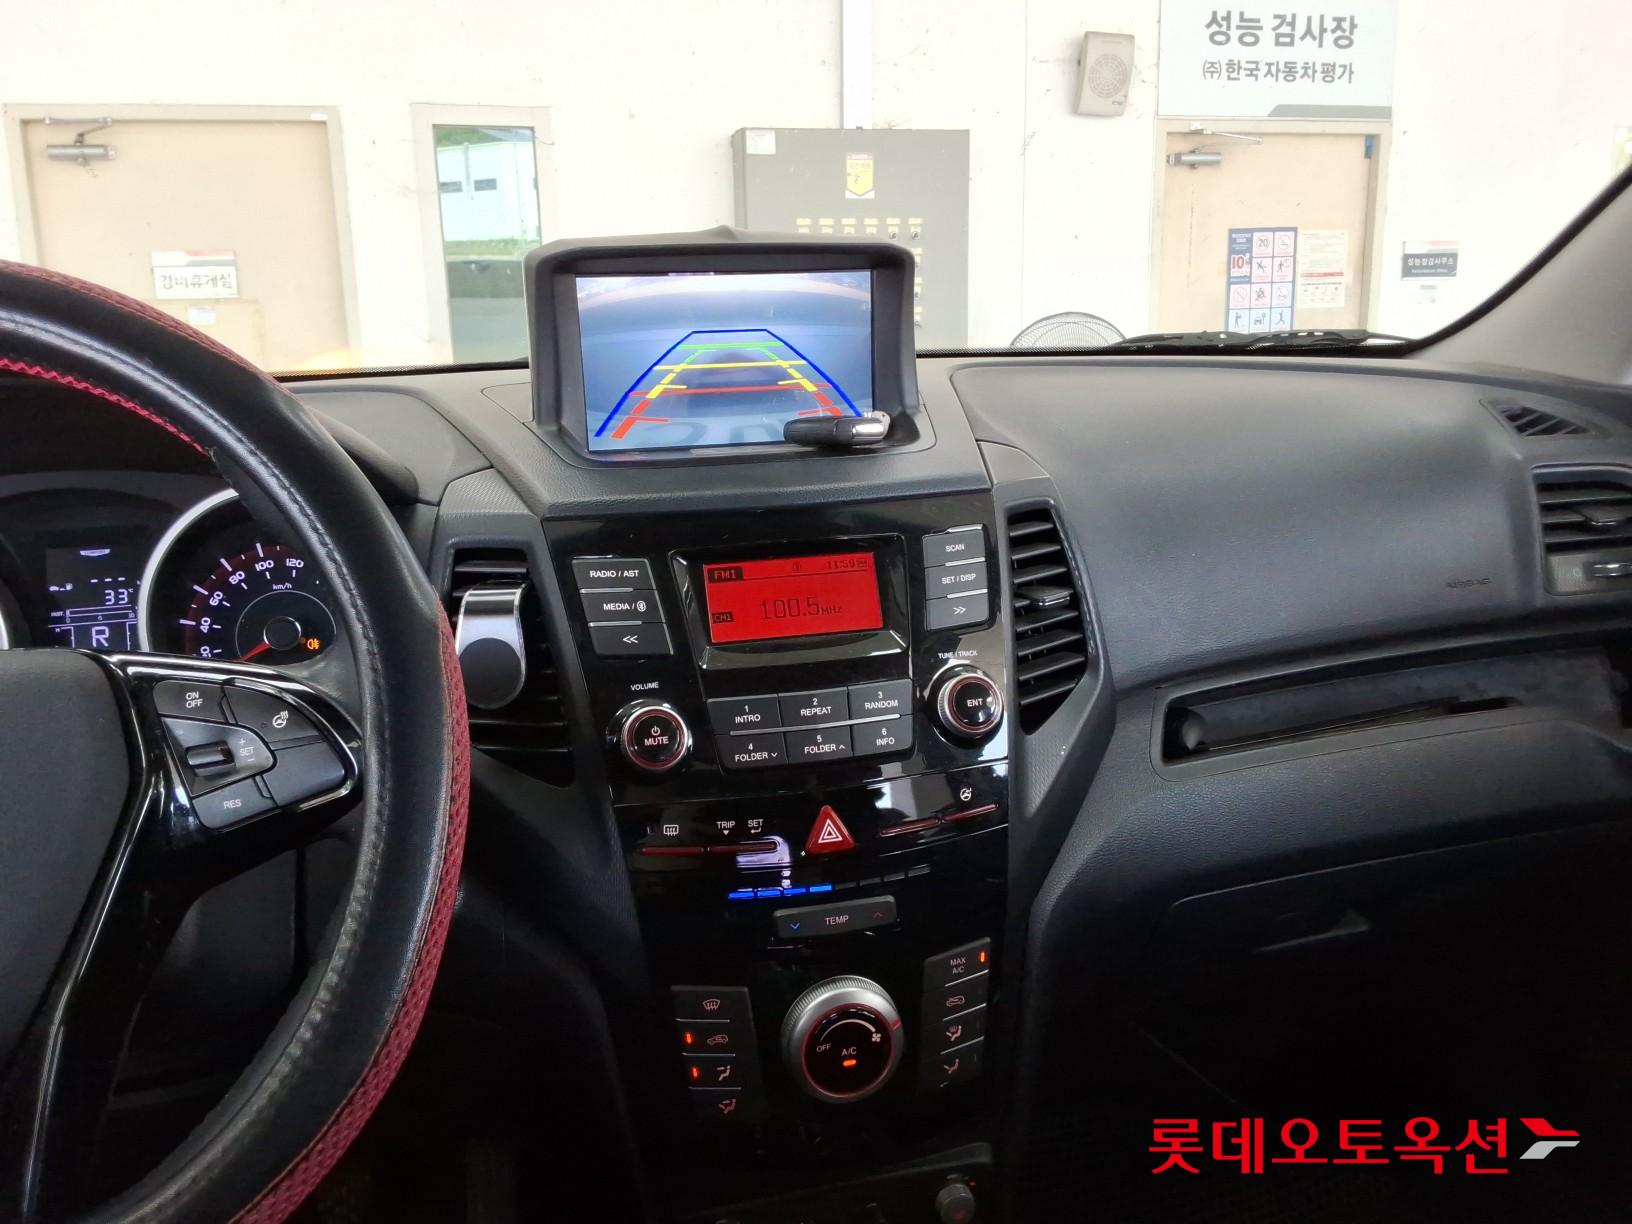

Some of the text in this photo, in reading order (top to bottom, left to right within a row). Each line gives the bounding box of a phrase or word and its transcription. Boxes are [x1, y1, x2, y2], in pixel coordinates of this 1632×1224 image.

[1204, 10, 1359, 49] 성능 검사장
[160, 272, 233, 290] 경비휴게실
[945, 543, 965, 552] SCAN
[255, 559, 275, 572] 100
[286, 558, 304, 568] 120
[827, 559, 855, 569] 11:59
[228, 570, 246, 585] 80
[589, 570, 616, 578] RADIO
[623, 569, 640, 577] AST
[713, 570, 737, 580] FM1
[941, 575, 955, 584] SET
[960, 573, 976, 581] DISP
[272, 582, 293, 590] km/h
[209, 591, 223, 606] 60
[603, 603, 630, 611] MEDIA
[199, 617, 211, 633] 40
[91, 625, 109, 647] R
[938, 651, 954, 659] TUNE
[958, 649, 978, 657] TRACK
[630, 681, 659, 691] VOLUME
[185, 691, 200, 700] ON
[185, 699, 203, 708] OFF
[864, 699, 898, 710] RANDOM
[966, 698, 983, 707] ENT
[744, 705, 749, 713] 1
[800, 706, 832, 717] REPEAT
[735, 713, 761, 724] INTRO
[881, 728, 887, 736] 6
[644, 736, 669, 746] MUTE
[816, 735, 822, 743] 5
[876, 737, 895, 746] INFO
[239, 747, 254, 756] SET
[747, 743, 754, 751] 4
[804, 743, 837, 754] FOLDER
[734, 752, 769, 763] FOLDER
[223, 799, 242, 809] RES
[716, 821, 736, 829] TRIP
[747, 818, 764, 827] SET
[824, 915, 849, 925] TEMP
[950, 956, 966, 966] MAX
[952, 966, 965, 975] A/C
[816, 1043, 832, 1053] OFF
[841, 1046, 857, 1056] A/C
